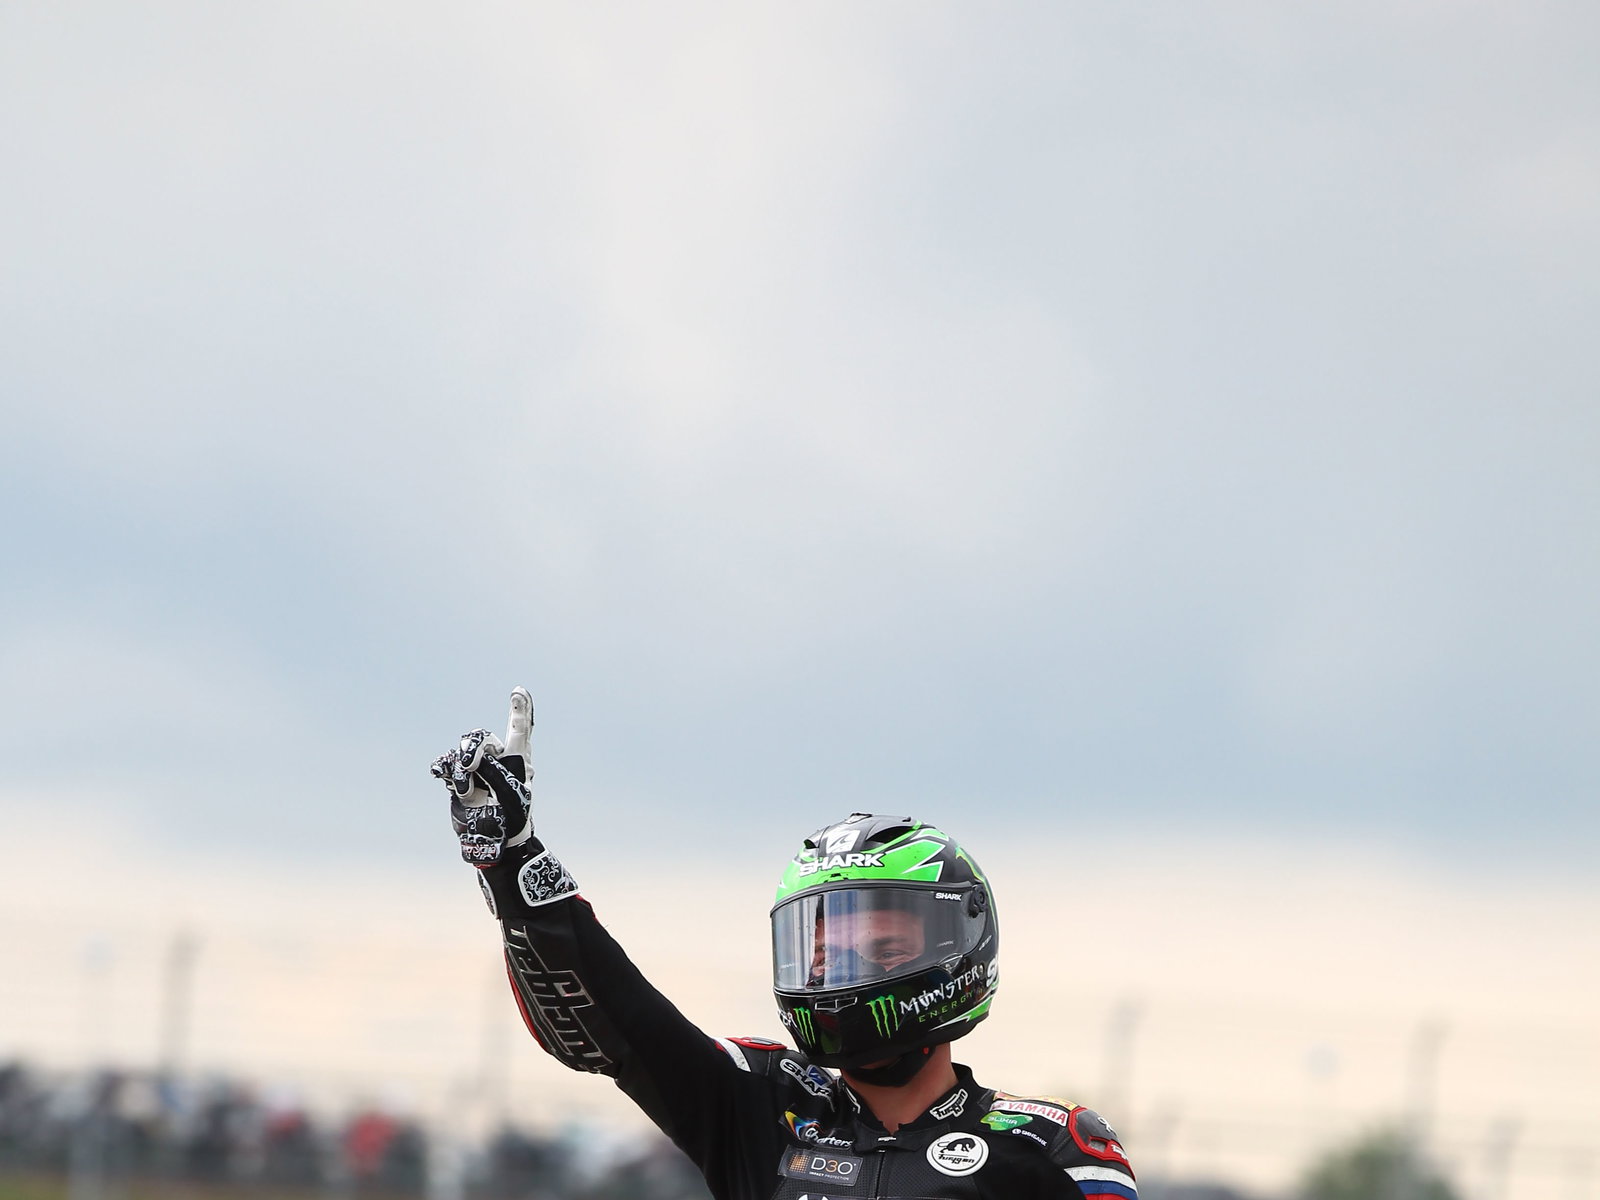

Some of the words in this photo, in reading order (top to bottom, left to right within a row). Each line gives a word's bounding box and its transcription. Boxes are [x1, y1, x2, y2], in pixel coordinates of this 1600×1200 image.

[799, 852, 887, 877] SHARK
[935, 892, 962, 901] SHARK
[900, 965, 981, 1015] MONSTER
[919, 989, 974, 1023] ENERGY
[782, 1060, 833, 1096] SHAR
[1007, 1102, 1066, 1124] YAMAHA
